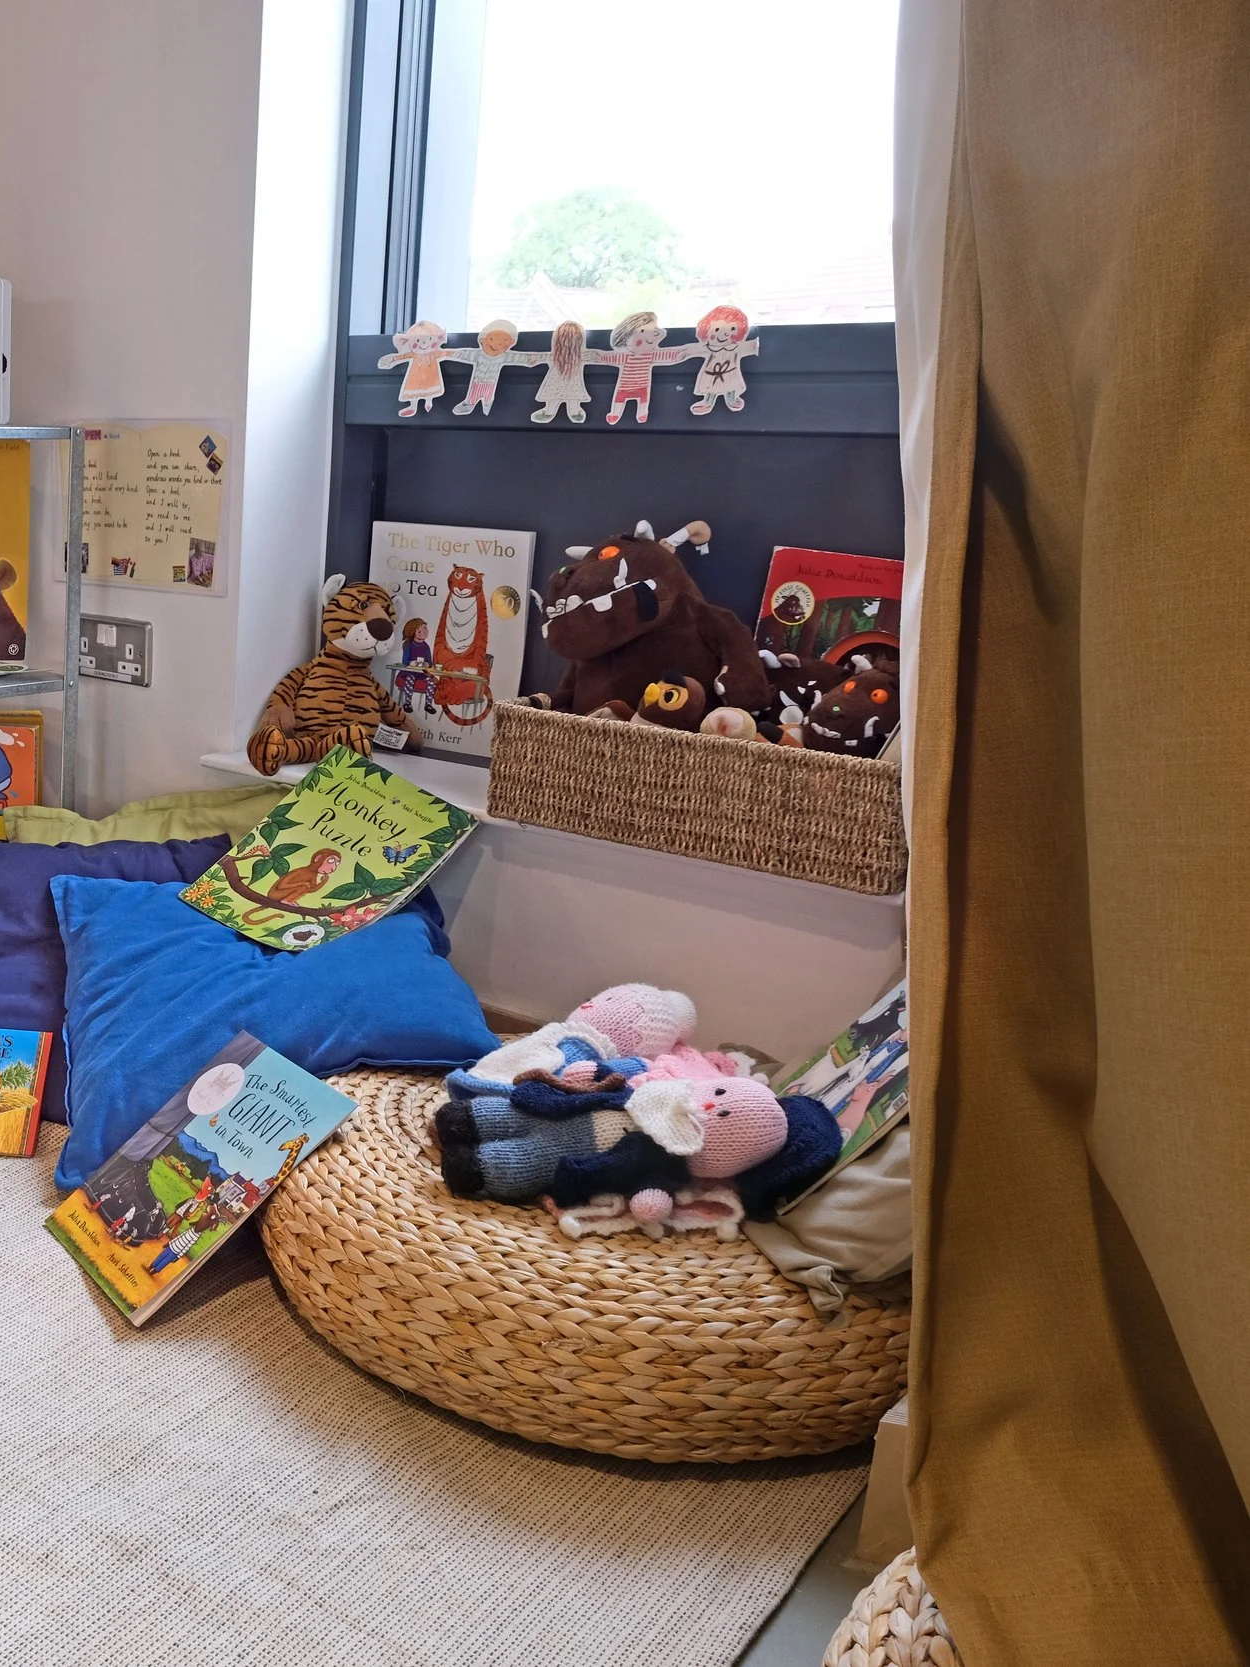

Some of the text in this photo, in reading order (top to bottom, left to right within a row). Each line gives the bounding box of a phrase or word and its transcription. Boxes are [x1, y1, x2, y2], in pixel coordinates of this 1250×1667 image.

[85, 430, 101, 440] PEN
[147, 449, 159, 461] Open
[169, 449, 180, 457] book
[146, 485, 157, 496] Open
[388, 532, 515, 559] The Tiger Who
[386, 555, 435, 573] Came
[796, 564, 821, 578] Julia
[824, 568, 883, 586] Donaldson
[406, 579, 438, 597] Tea
[438, 731, 462, 744] Kerr
[345, 774, 361, 785] Julia
[317, 780, 408, 843] Monkey
[310, 808, 373, 858] Puzzle
[245, 1073, 318, 1128] The Smartest
[228, 1093, 295, 1145] GIANT
[214, 1122, 254, 1159] in Town
[68, 1210, 100, 1247] Julia Donaldson
[107, 1253, 138, 1287] Axel Scheffler
